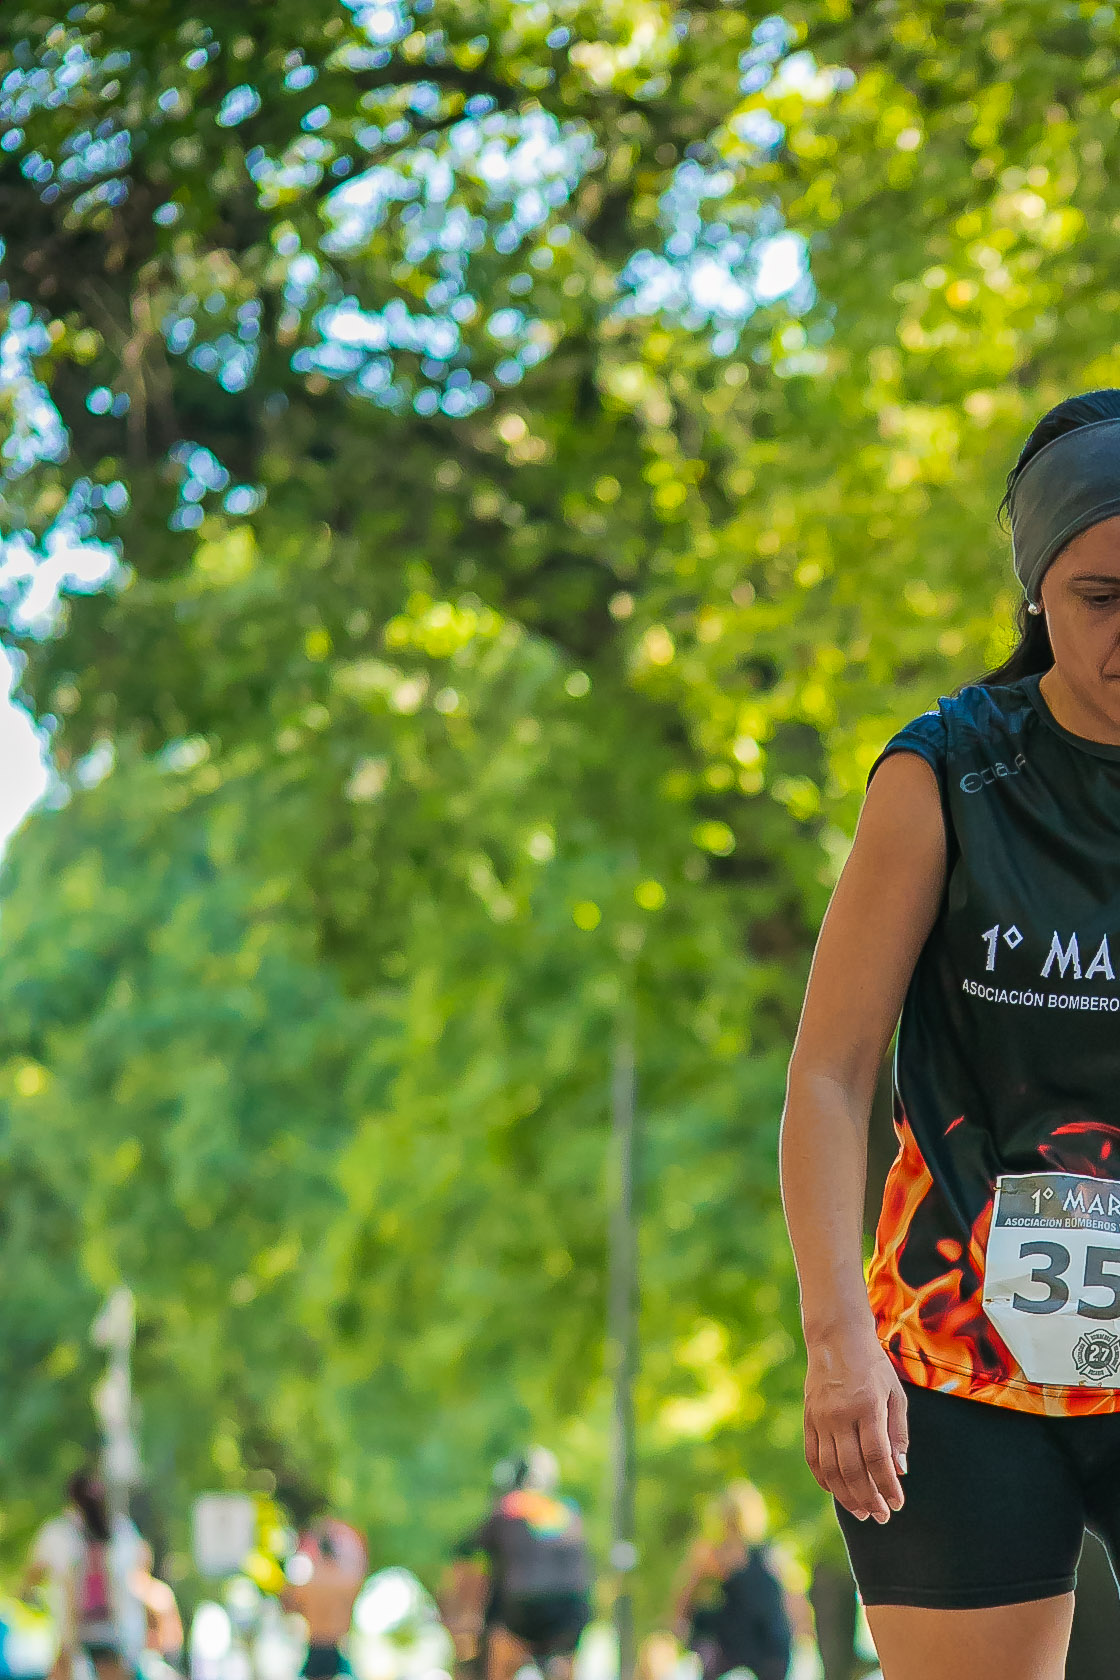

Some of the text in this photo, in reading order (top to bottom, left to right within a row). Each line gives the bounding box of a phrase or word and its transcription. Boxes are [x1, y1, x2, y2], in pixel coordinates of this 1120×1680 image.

[962, 978, 1044, 1007] ASOCIACIÓN
[1004, 1216, 1062, 1228] ASOCIACIÓN
[1065, 1217, 1117, 1232] BOMBEROS
[1089, 1344, 1110, 1362] 27
